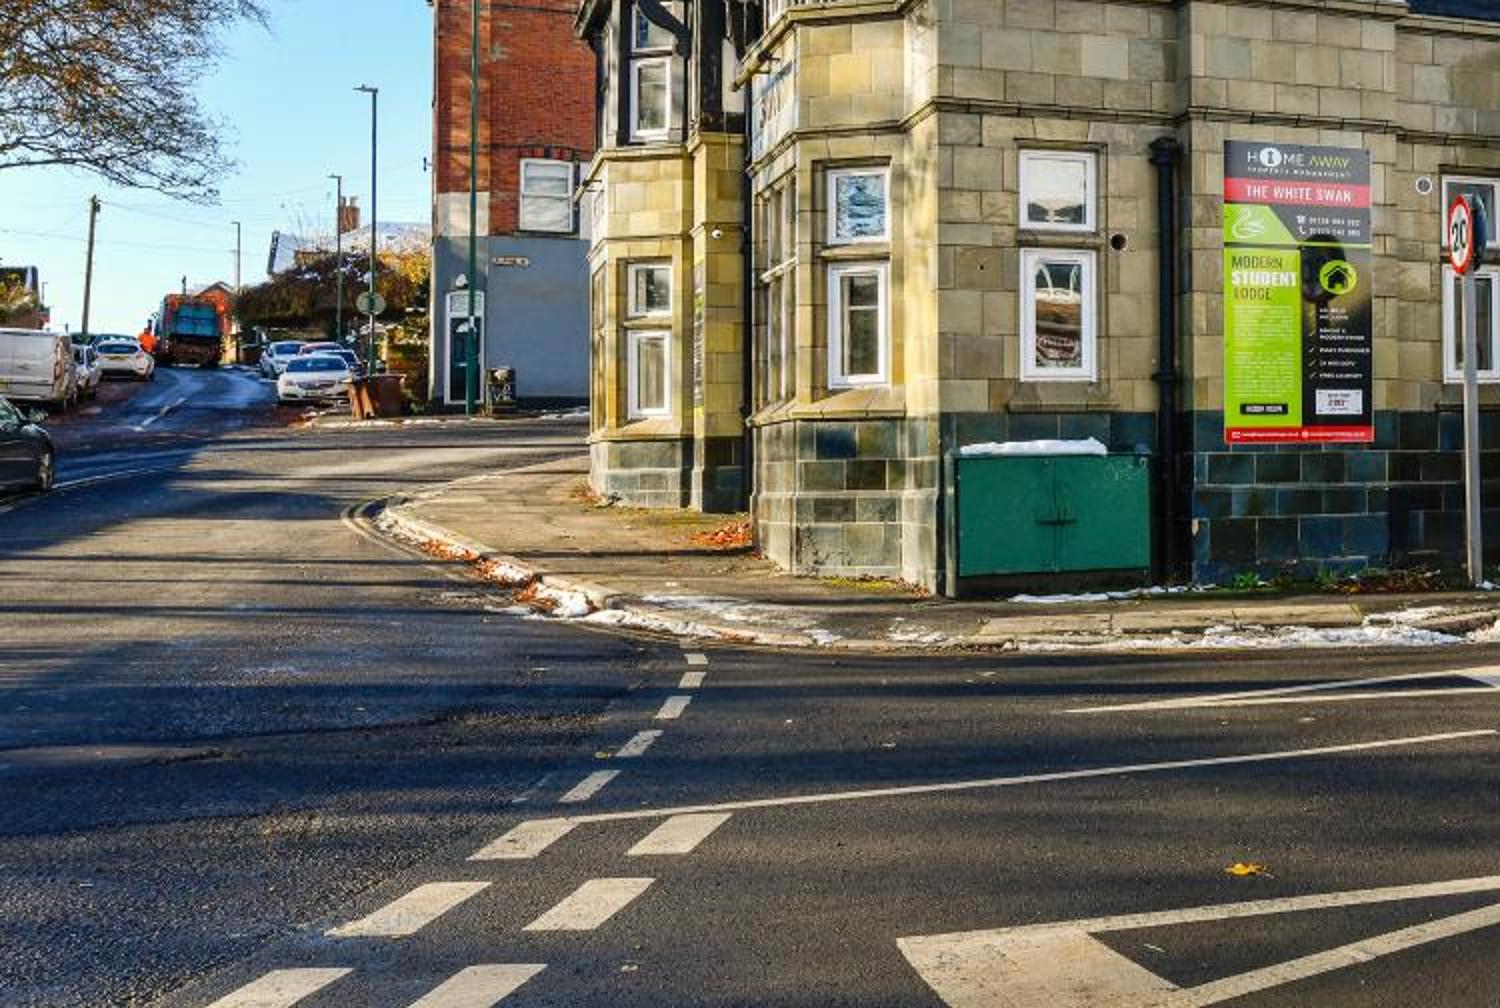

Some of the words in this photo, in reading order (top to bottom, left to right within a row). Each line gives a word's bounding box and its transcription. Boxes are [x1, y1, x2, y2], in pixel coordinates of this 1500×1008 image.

[1247, 147, 1305, 167] HOME
[1310, 155, 1350, 168] AWAY
[1247, 184, 1269, 199] THE
[1273, 186, 1313, 202] WHITE
[1315, 189, 1351, 204] SWAN
[1231, 255, 1283, 269] MODERN
[1231, 271, 1297, 287] STUDENT
[1233, 287, 1271, 301] LODGE
